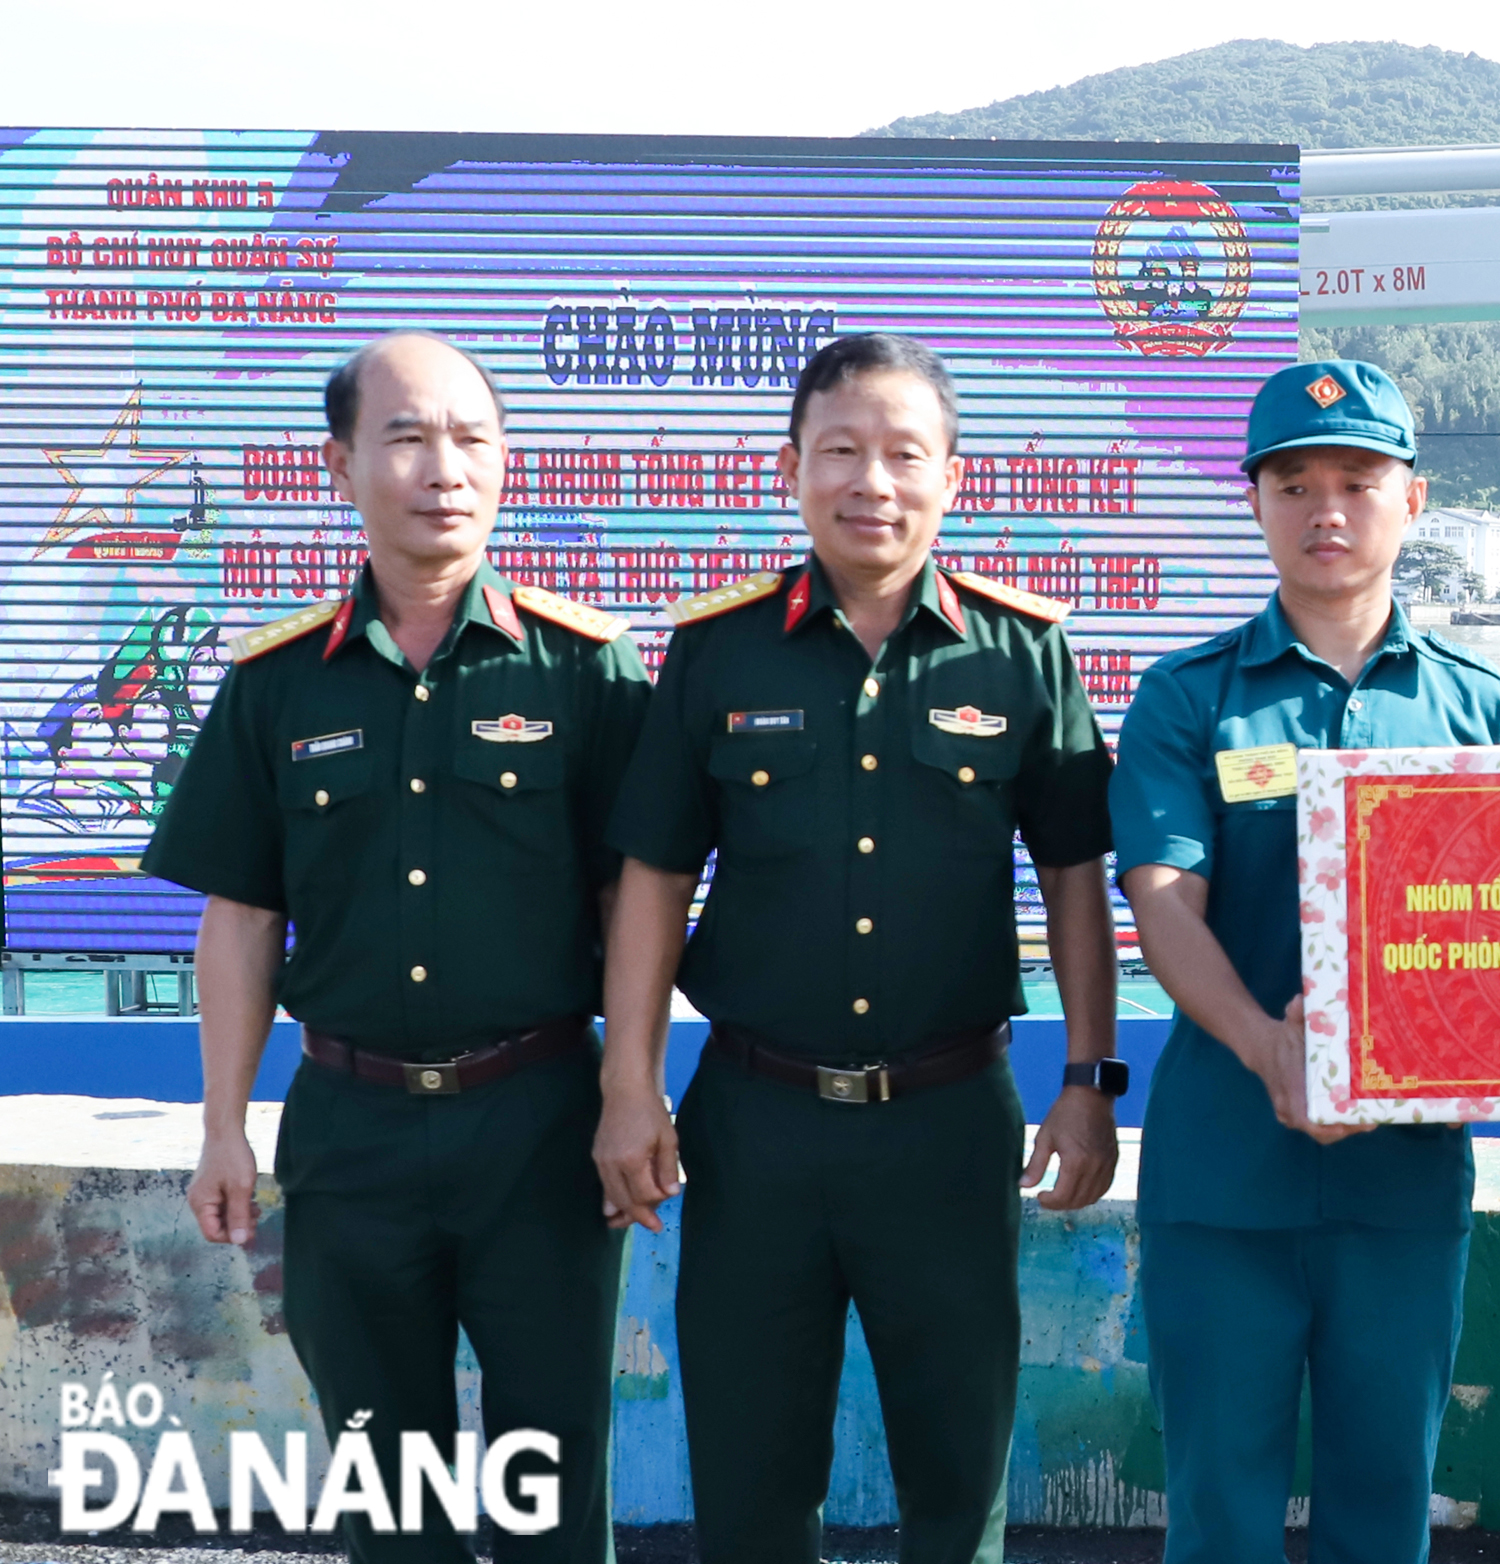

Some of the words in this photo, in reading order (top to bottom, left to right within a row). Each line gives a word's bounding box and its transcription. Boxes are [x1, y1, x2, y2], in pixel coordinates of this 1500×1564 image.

[106, 172, 183, 212] QUÂN
[192, 179, 248, 208] KHU
[257, 181, 274, 208] 5
[46, 231, 83, 274] BỘ
[92, 229, 139, 267] CHÍ
[147, 237, 202, 268] HUY
[210, 233, 289, 269] QUÂN
[295, 234, 340, 278] SỰ
[1316, 269, 1365, 295] 2.0T
[1372, 273, 1386, 292] x
[1393, 266, 1425, 292] 8M
[545, 286, 675, 387] CHÀO
[1005, 431, 1079, 513] TỔNG
[1089, 438, 1140, 514] KẾT
[1091, 550, 1160, 610] THEO
[1405, 878, 1472, 912] NHÓM
[1383, 933, 1442, 973] QUỐC
